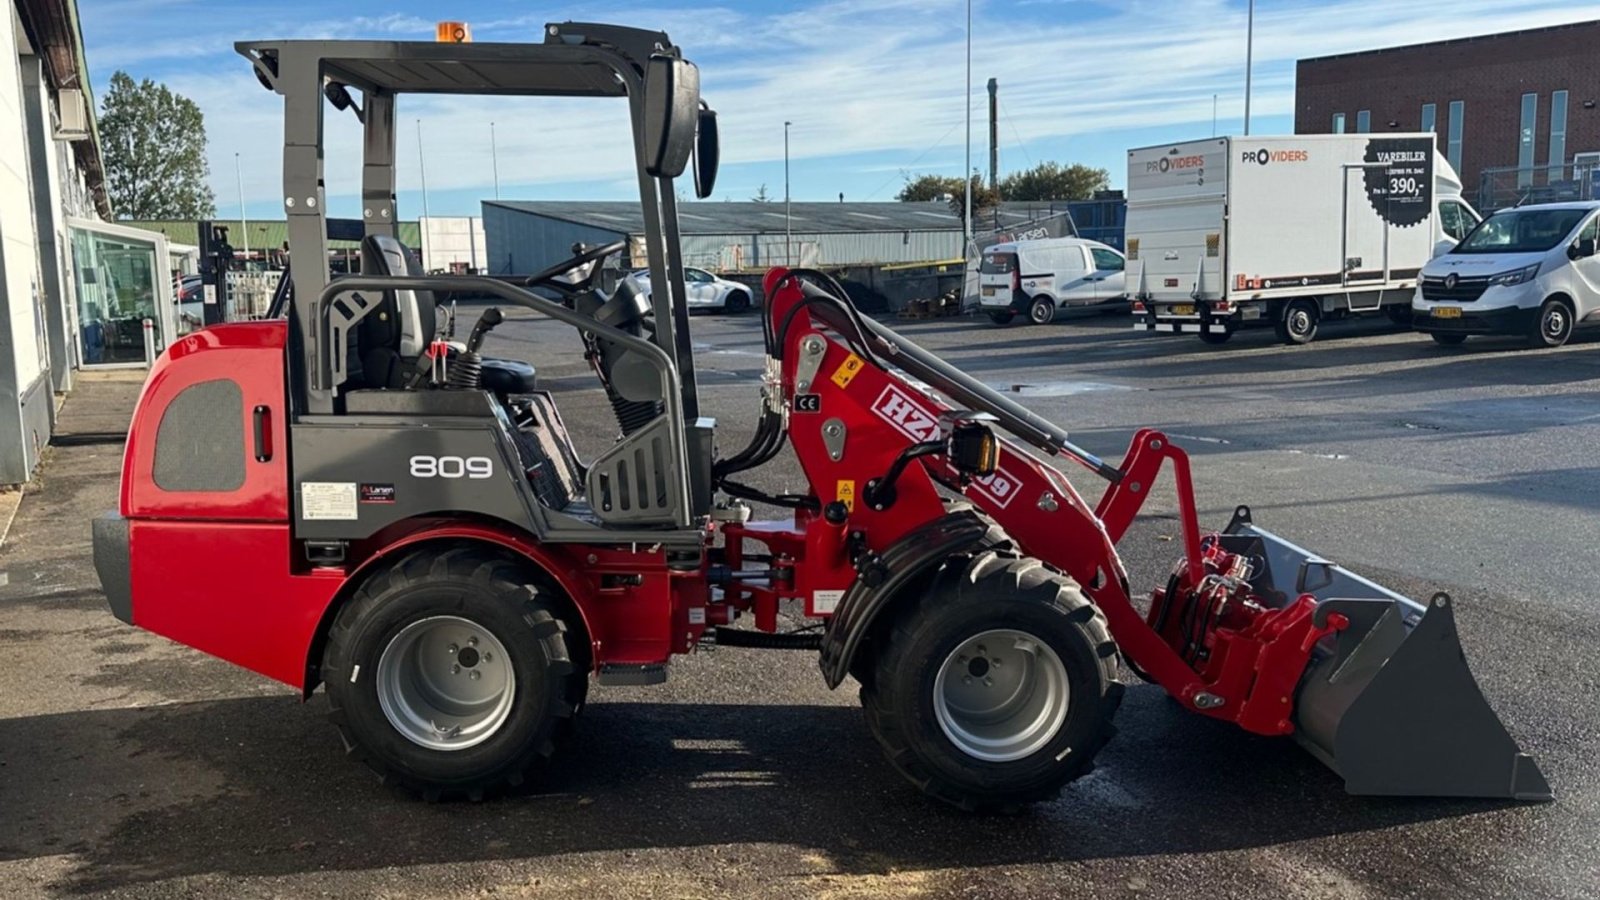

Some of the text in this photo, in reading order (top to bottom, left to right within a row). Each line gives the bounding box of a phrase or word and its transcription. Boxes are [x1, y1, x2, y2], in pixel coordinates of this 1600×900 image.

[1146, 155, 1204, 172] PROVIDERS
[1242, 148, 1308, 166] PROVIDERS
[1377, 152, 1426, 162] VAREBILER
[1390, 178, 1424, 197] 390,-
[409, 455, 493, 479] 809
[369, 485, 394, 494] Larsen
